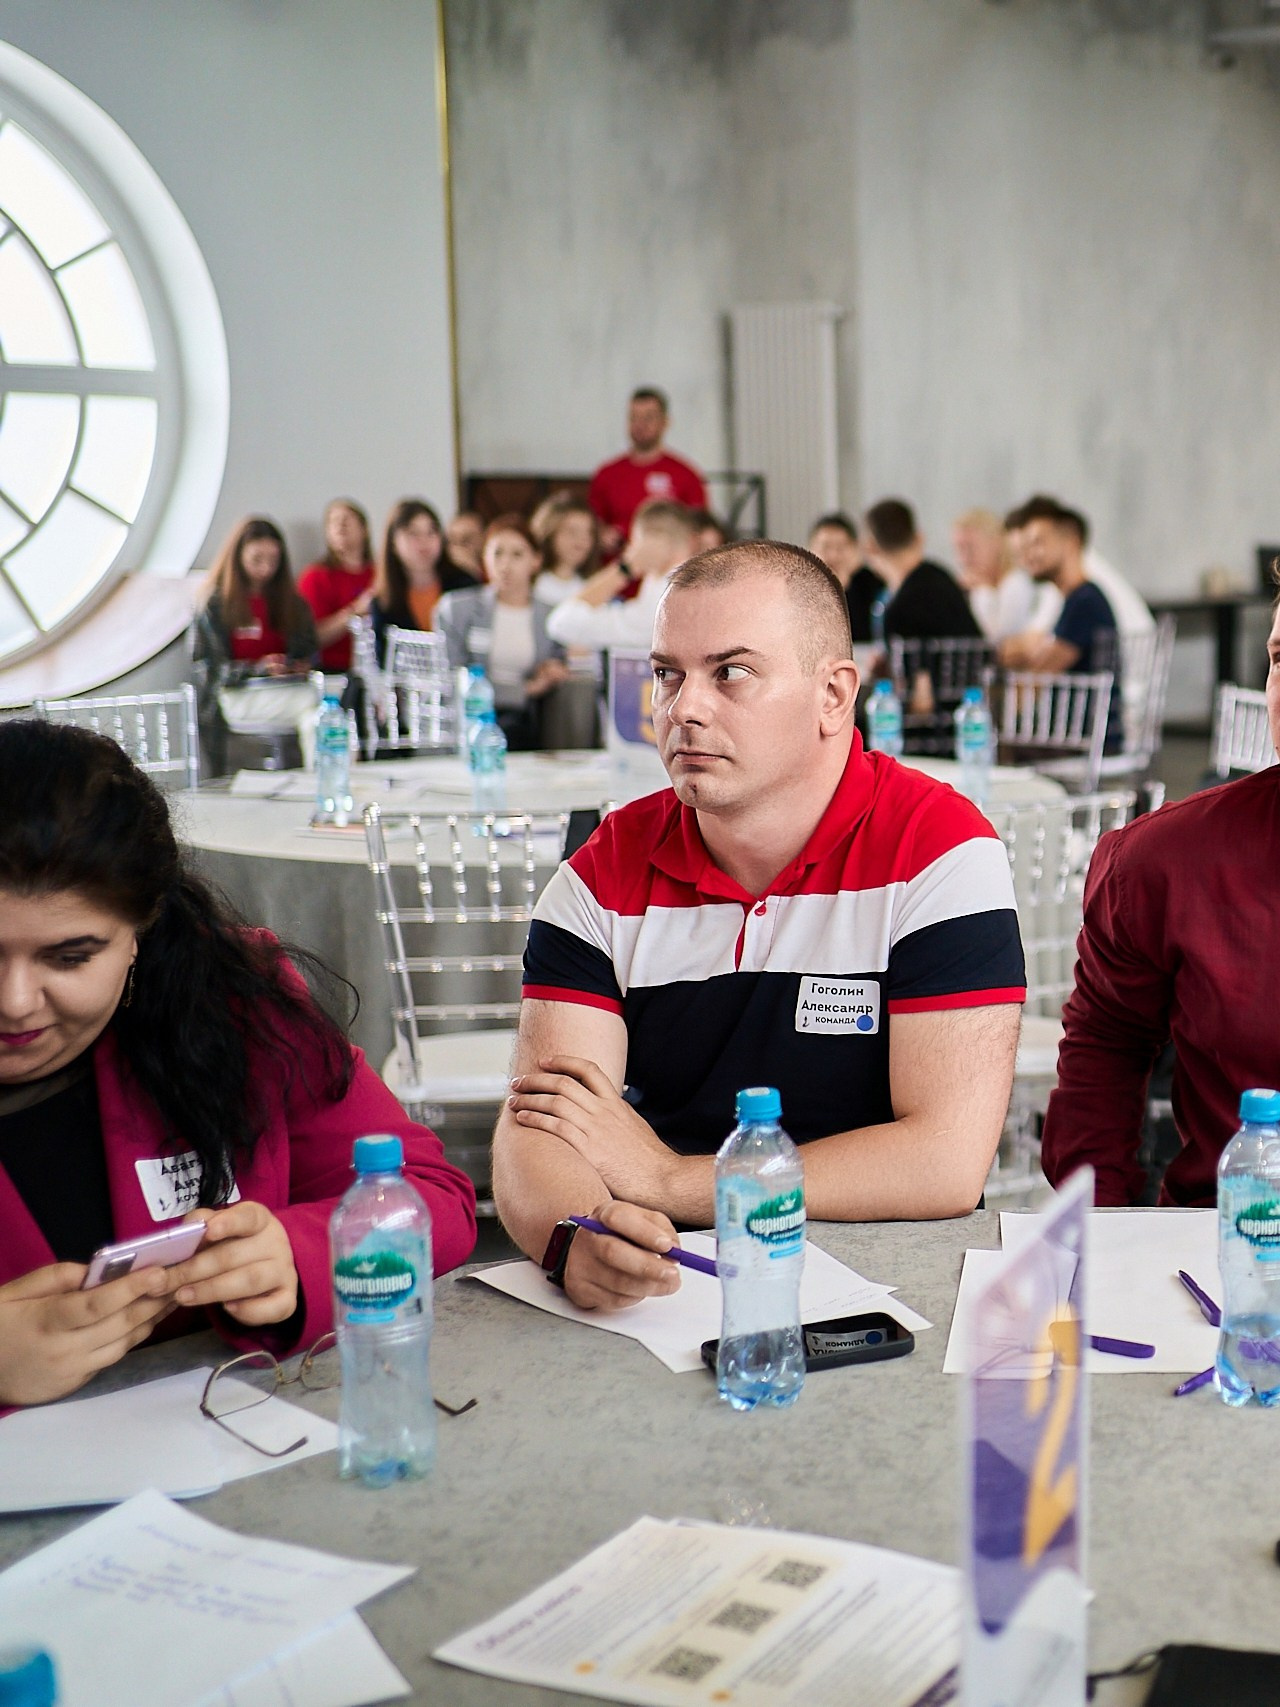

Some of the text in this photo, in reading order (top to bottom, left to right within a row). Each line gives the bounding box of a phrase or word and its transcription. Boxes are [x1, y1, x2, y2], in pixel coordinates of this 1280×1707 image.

[811, 983, 864, 996] Гоголин
[801, 1000, 873, 1016] Александр
[815, 1016, 856, 1024] КОМАНДА
